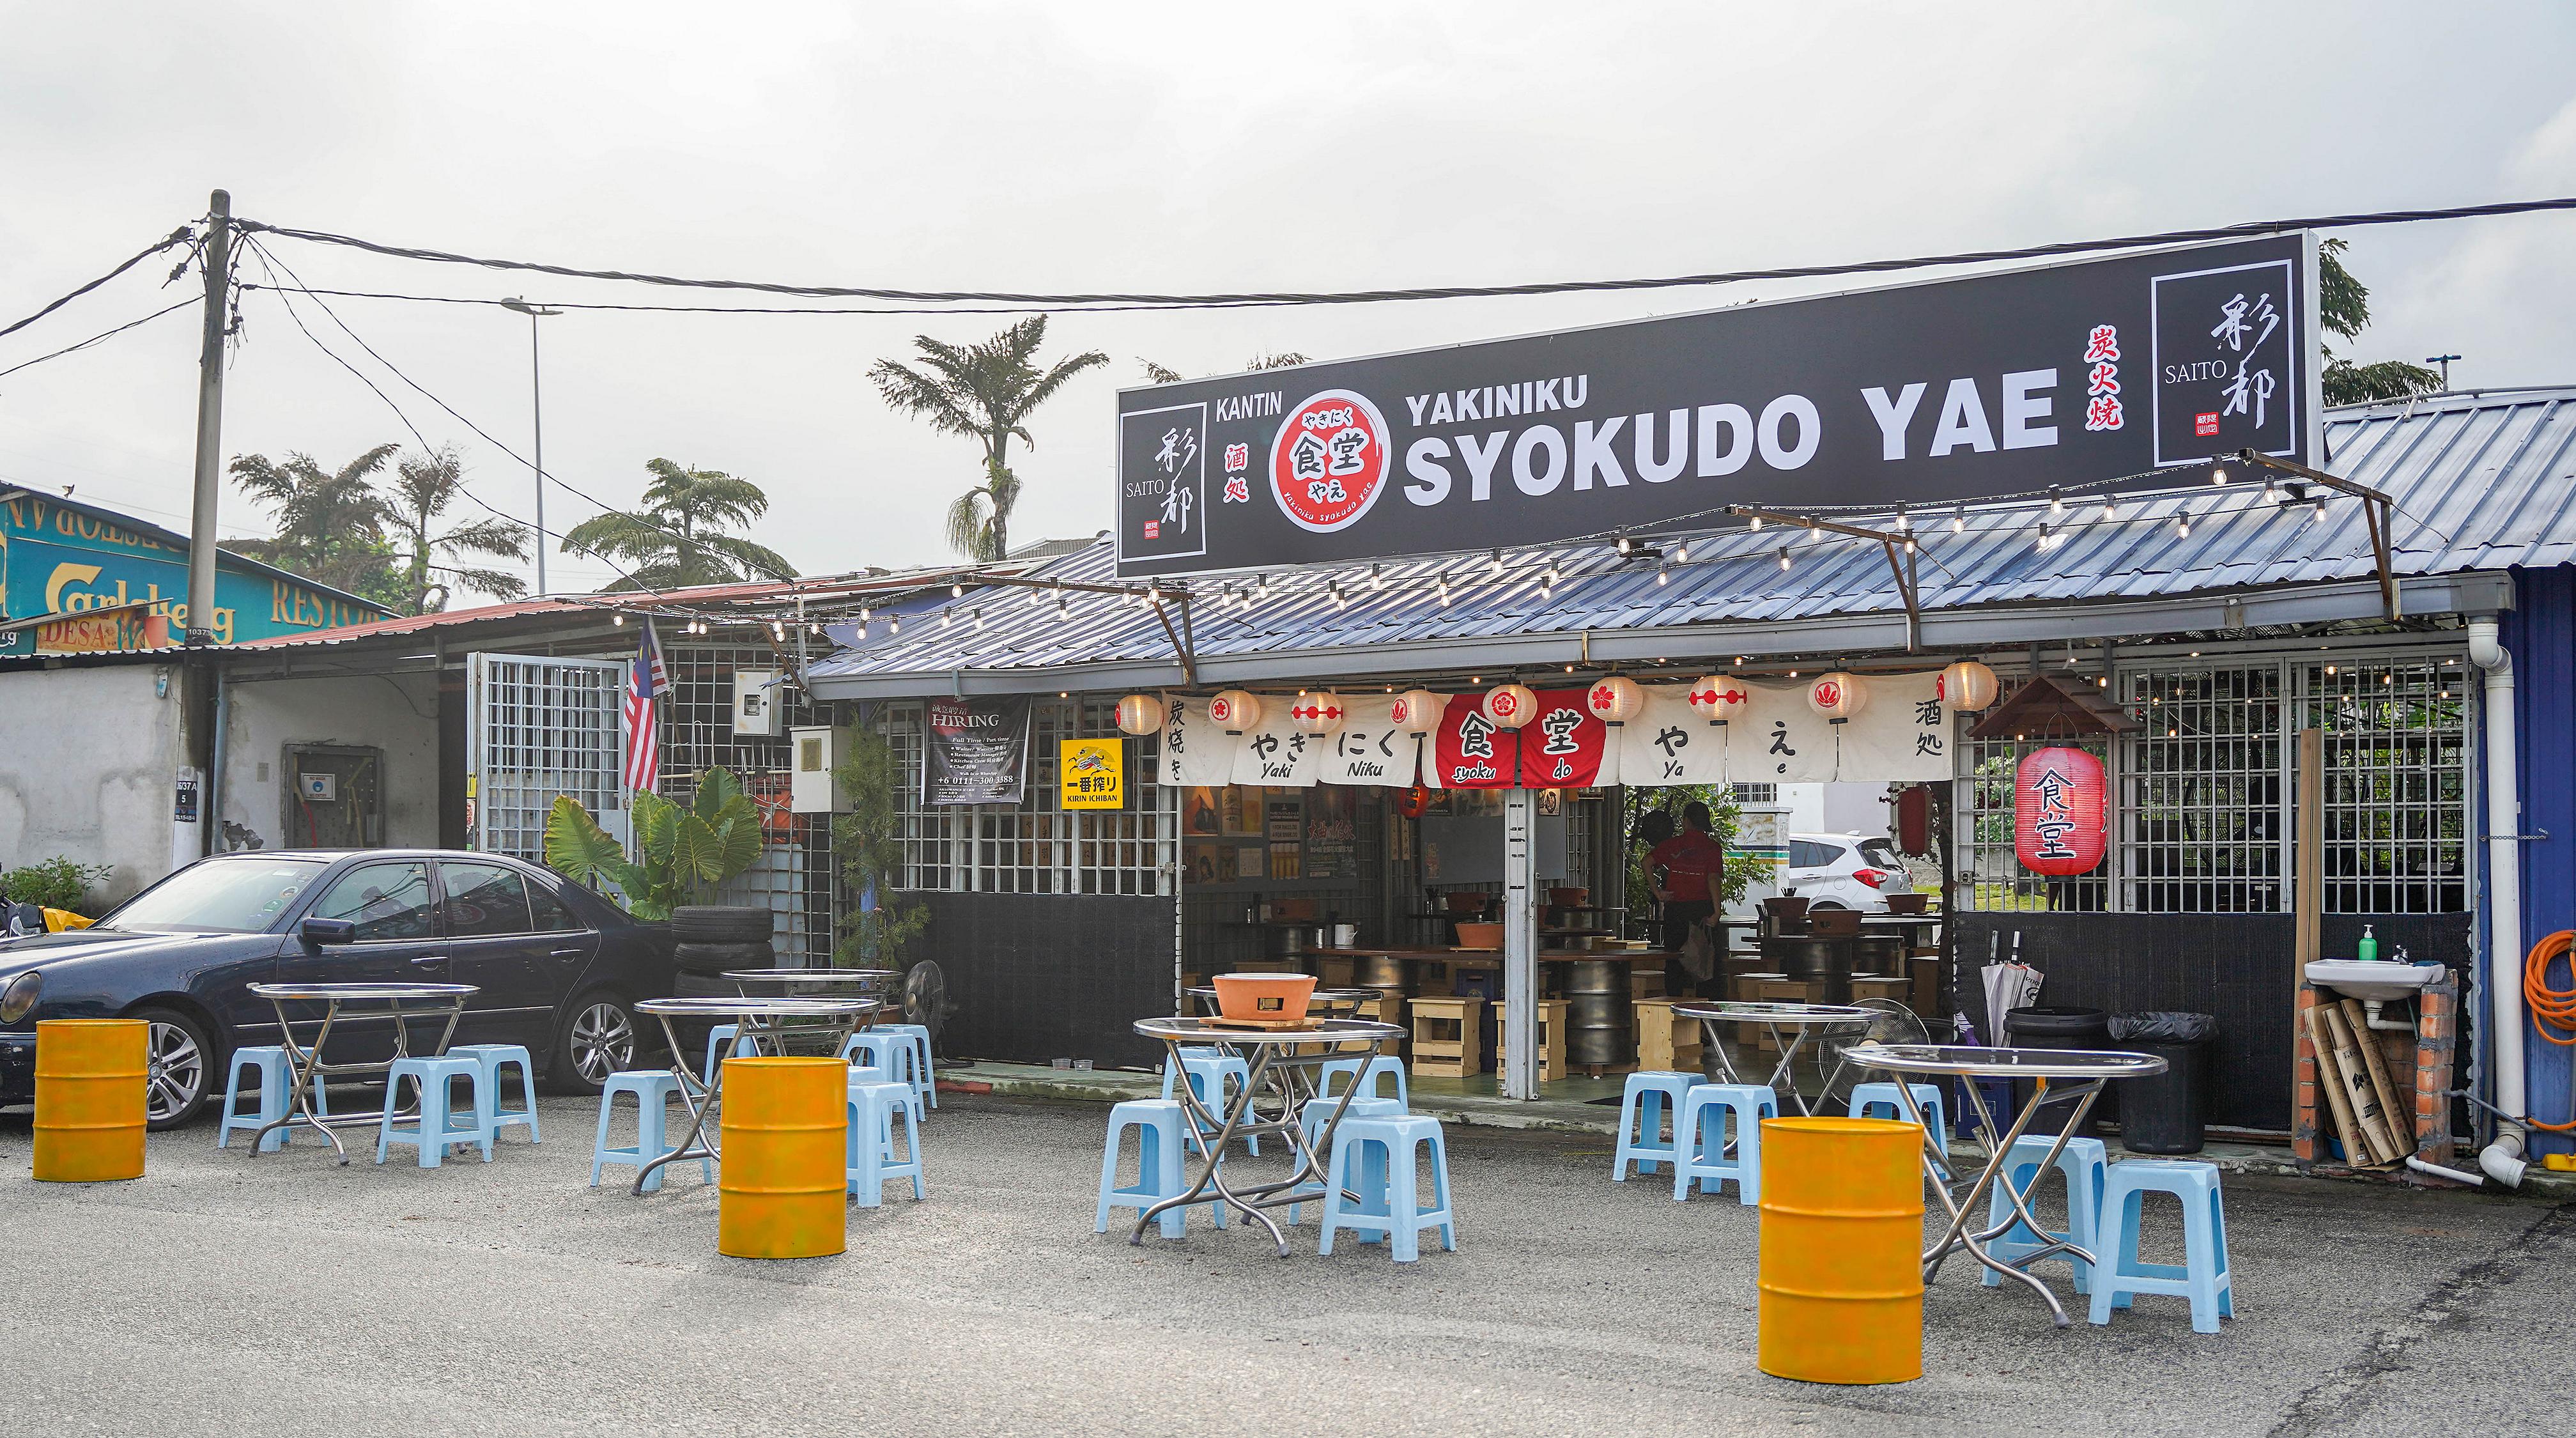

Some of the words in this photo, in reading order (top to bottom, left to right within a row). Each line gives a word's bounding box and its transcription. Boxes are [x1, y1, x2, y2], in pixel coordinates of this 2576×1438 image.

[2086, 326, 2122, 429] 炭火焼
[2165, 359, 2227, 385] SAITO
[1216, 390, 1283, 422] KANTIN
[1405, 374, 1588, 427] YAKINIKU
[1304, 407, 1354, 428] やきにく
[1404, 394, 1821, 507] SYOKUDO
[1860, 367, 2058, 461] YAE
[1294, 431, 1365, 475] 食堂
[1225, 445, 1249, 501] 酒処
[1126, 479, 1164, 499] SAITO
[1311, 482, 1345, 500] やえ
[45, 620, 106, 648] DESA
[932, 715, 999, 727] HIRING
[996, 775, 1014, 784] 3388
[1262, 763, 1292, 779] Yaki
[1347, 763, 1384, 778] Niku
[1453, 761, 1496, 784] syoku
[1553, 758, 1573, 780] do
[1777, 762, 1786, 775] e
[1067, 777, 1116, 792] 一番搾り
[2030, 767, 2076, 859] 食堂
